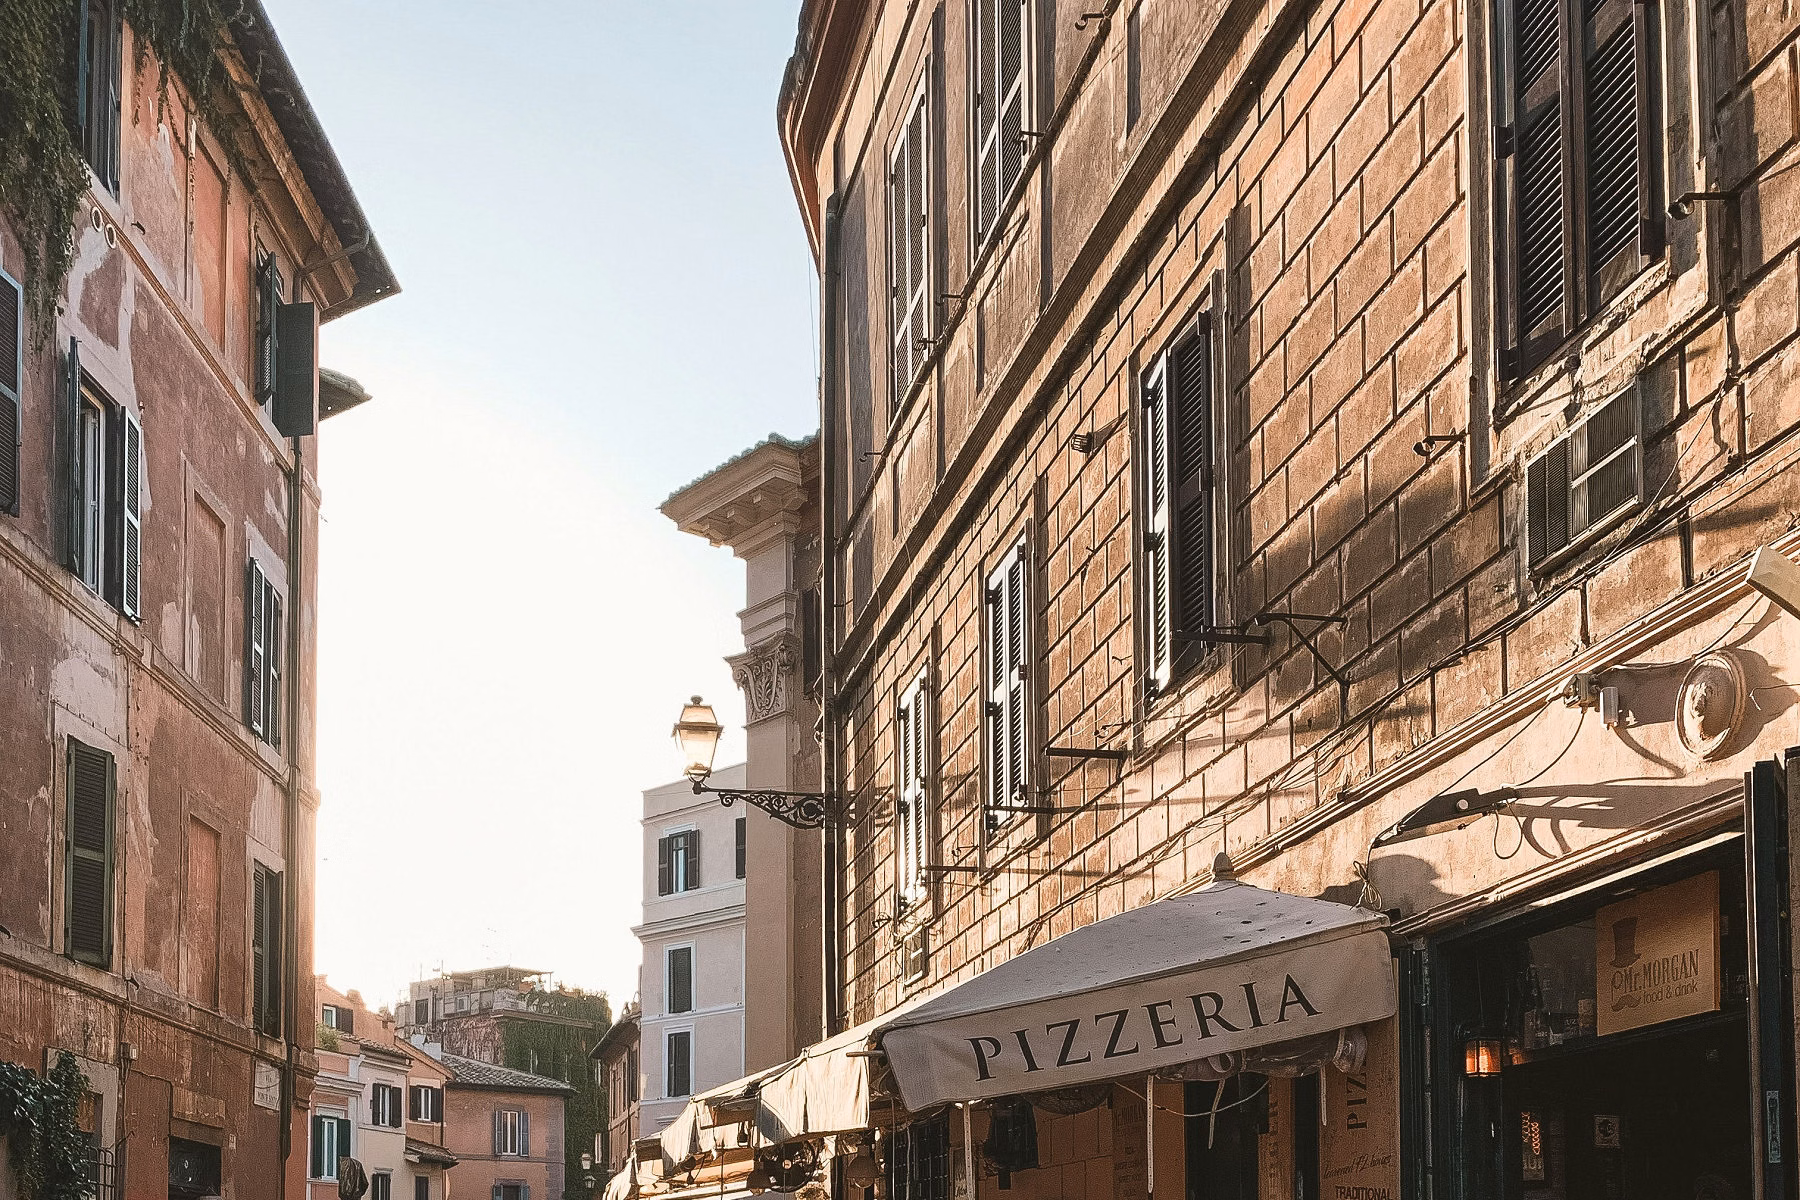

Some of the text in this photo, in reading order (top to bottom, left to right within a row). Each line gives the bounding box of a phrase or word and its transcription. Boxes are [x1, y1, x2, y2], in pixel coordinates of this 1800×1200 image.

[1643, 979, 1698, 1005] food & drink
[964, 973, 1323, 1081] PIZZERIA
